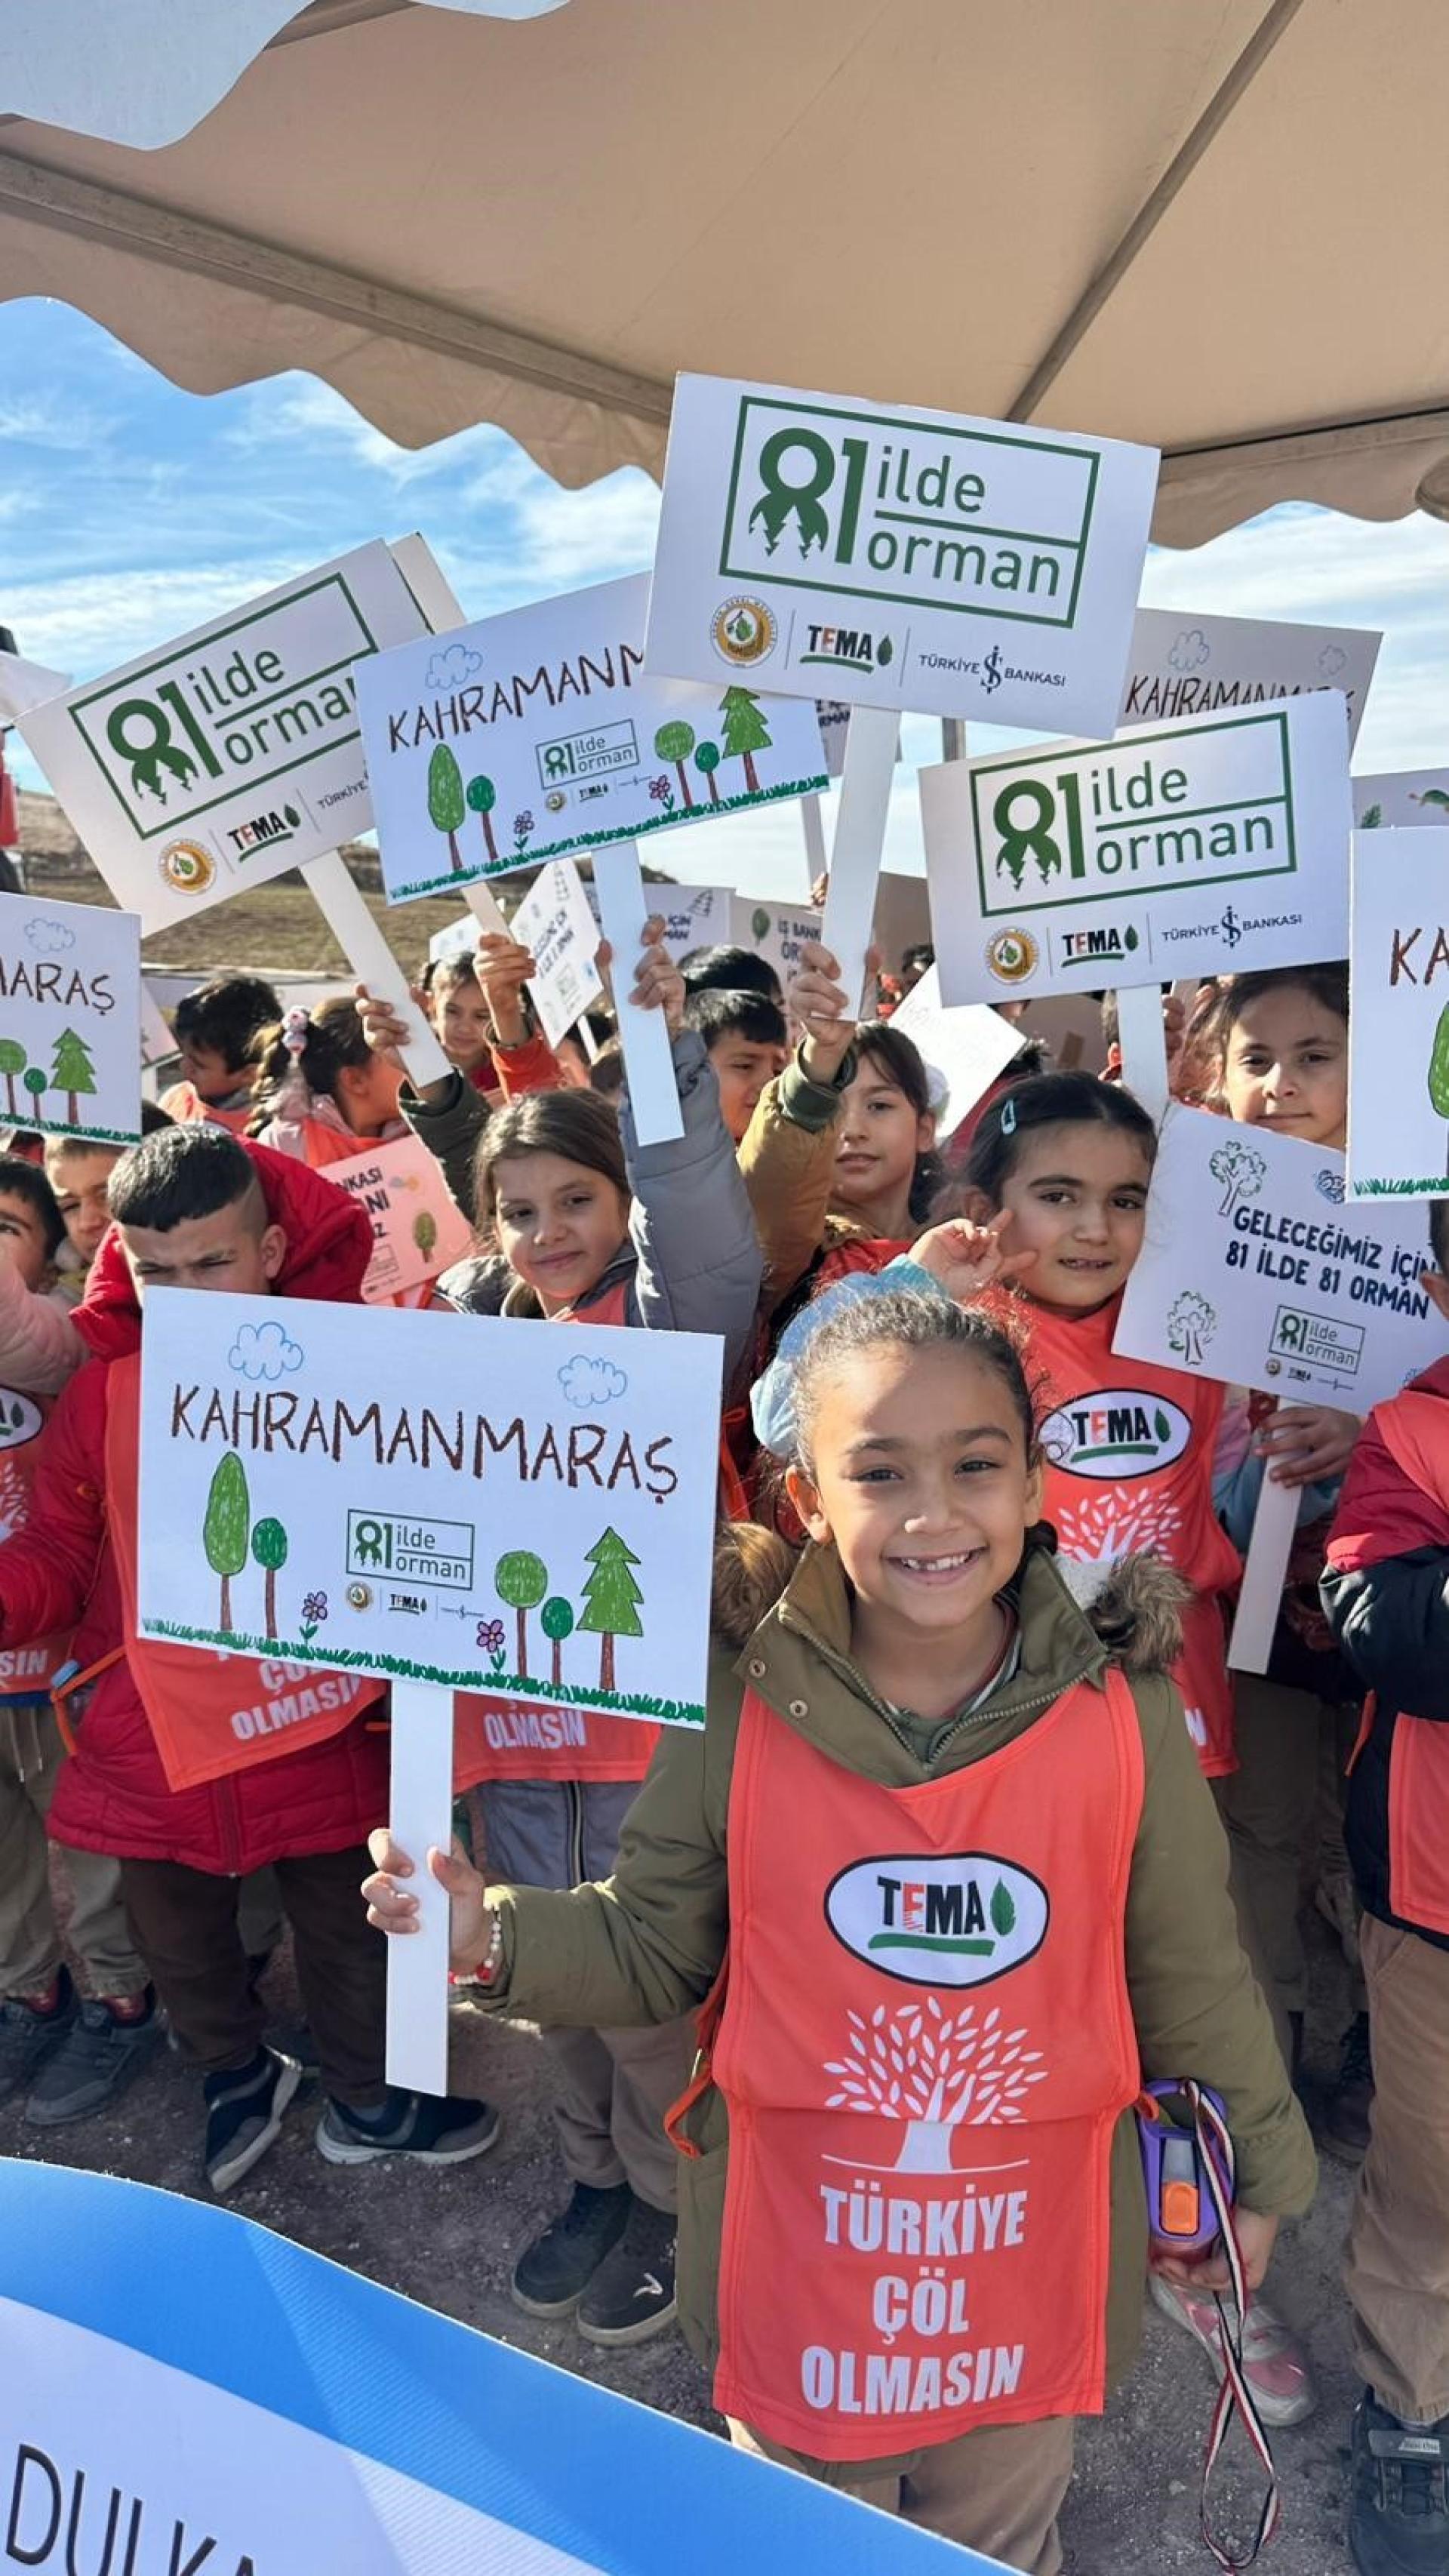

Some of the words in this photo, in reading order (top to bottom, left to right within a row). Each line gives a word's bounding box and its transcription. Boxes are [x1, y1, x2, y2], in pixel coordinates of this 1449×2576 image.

[877, 445, 986, 513] ilde
[868, 530, 1060, 596] orman
[808, 624, 872, 660] TEMA
[187, 650, 284, 714] ilde
[918, 654, 980, 674] TÜRKİYE
[1004, 668, 1066, 687] BANKASI
[575, 736, 605, 755] ilde
[578, 748, 632, 772] orman
[1091, 761, 1188, 817] ilde
[227, 811, 286, 851] TEMA
[1096, 815, 1274, 875] orman
[1062, 928, 1121, 957] TEMA
[1161, 925, 1220, 942] TÜRKİYE
[1242, 914, 1303, 931] BANKASI
[0, 954, 115, 1015] ARAŞ
[1234, 1206, 1383, 1269] GELECEĞİMİZ
[1226, 1240, 1247, 1270] 81
[1257, 1243, 1309, 1285] İLDE
[1318, 1266, 1340, 1294] 81
[1349, 1274, 1429, 1320] ORMAN
[1305, 1343, 1355, 1366] orman
[1309, 1320, 1338, 1341] ilde
[171, 1383, 678, 1503] KAHRAMANMARAŞ
[1072, 1407, 1152, 1445] TEMA
[396, 1524, 435, 1549] ilde
[395, 1556, 466, 1580] orman
[484, 1710, 586, 1749] OLMASIN
[877, 1876, 985, 1936] TEMA
[820, 2181, 1028, 2257] TÜRKİYE
[872, 2267, 969, 2345] ÇÖL
[801, 2344, 1024, 2414] OLMASIN
